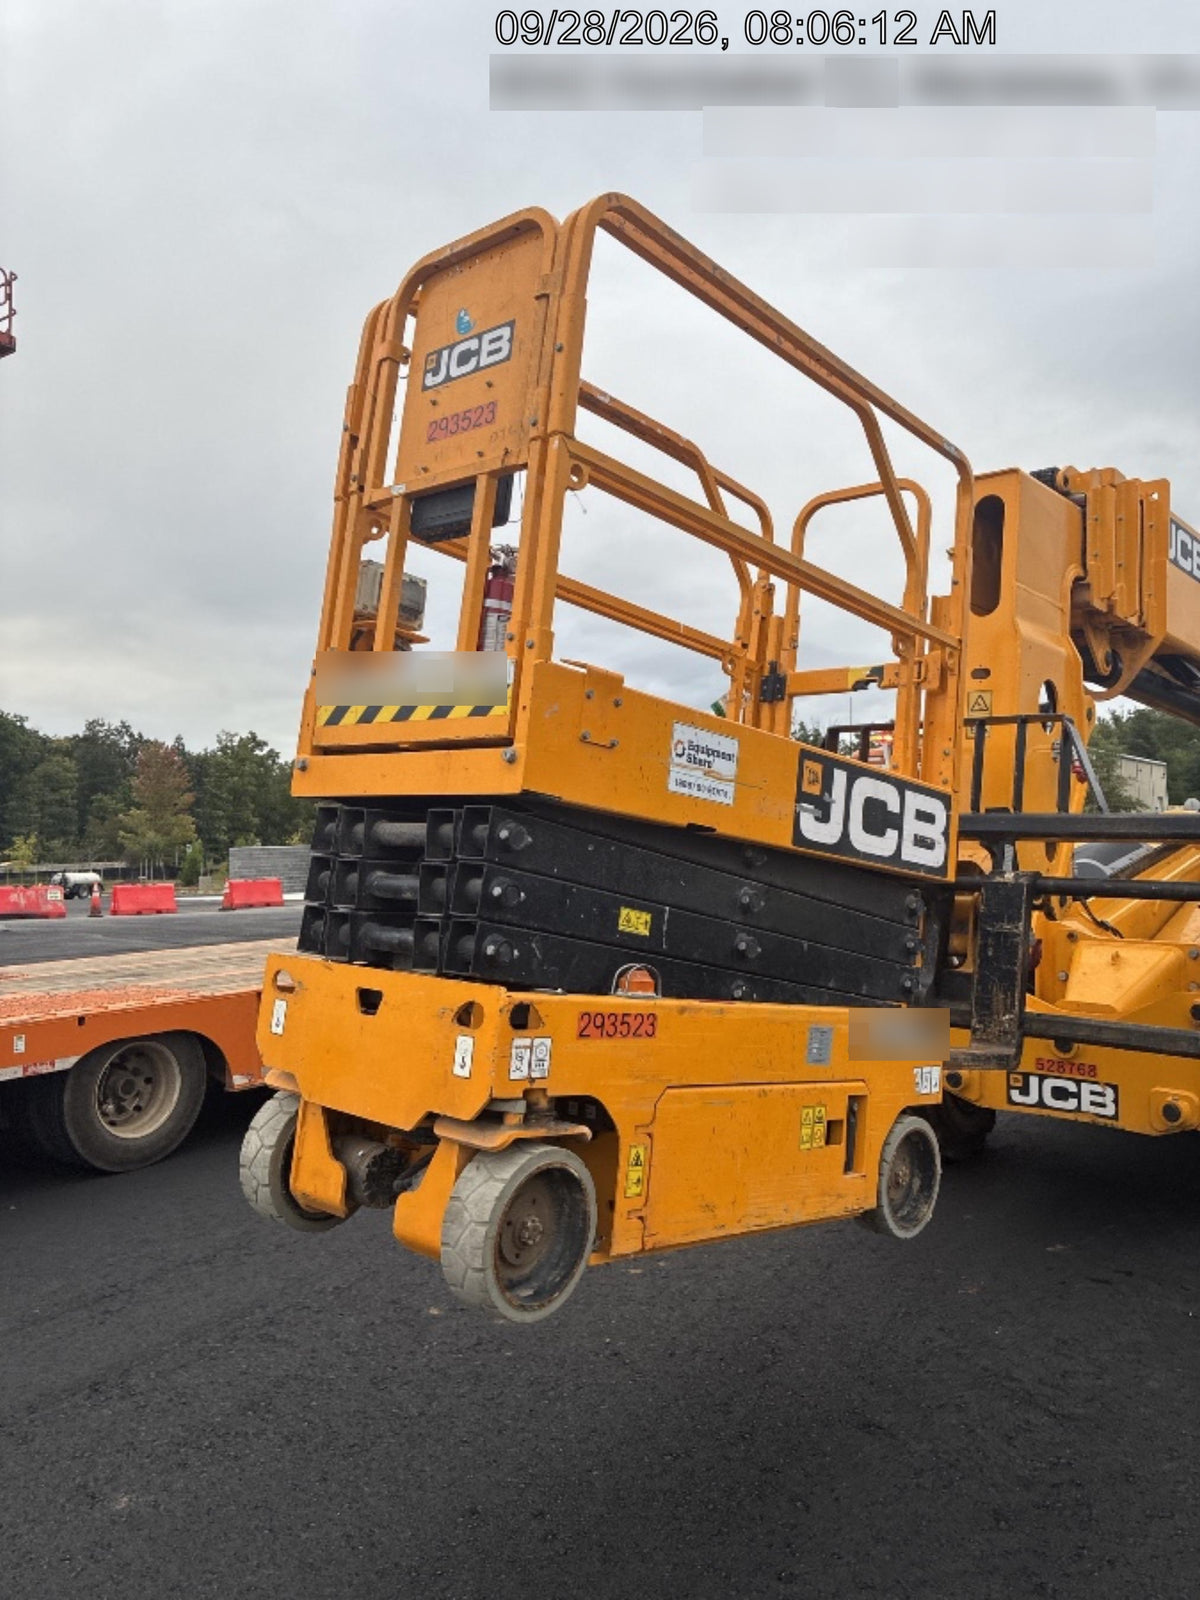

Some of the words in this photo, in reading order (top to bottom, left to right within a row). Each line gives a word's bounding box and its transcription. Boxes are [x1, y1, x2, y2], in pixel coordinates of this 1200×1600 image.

[424, 326, 511, 387] JCB
[427, 401, 497, 442] 293523
[799, 767, 948, 868] JCB
[578, 1012, 657, 1038] 293523
[1035, 1058, 1097, 1078] 528768
[1010, 1075, 1116, 1117] JCB
